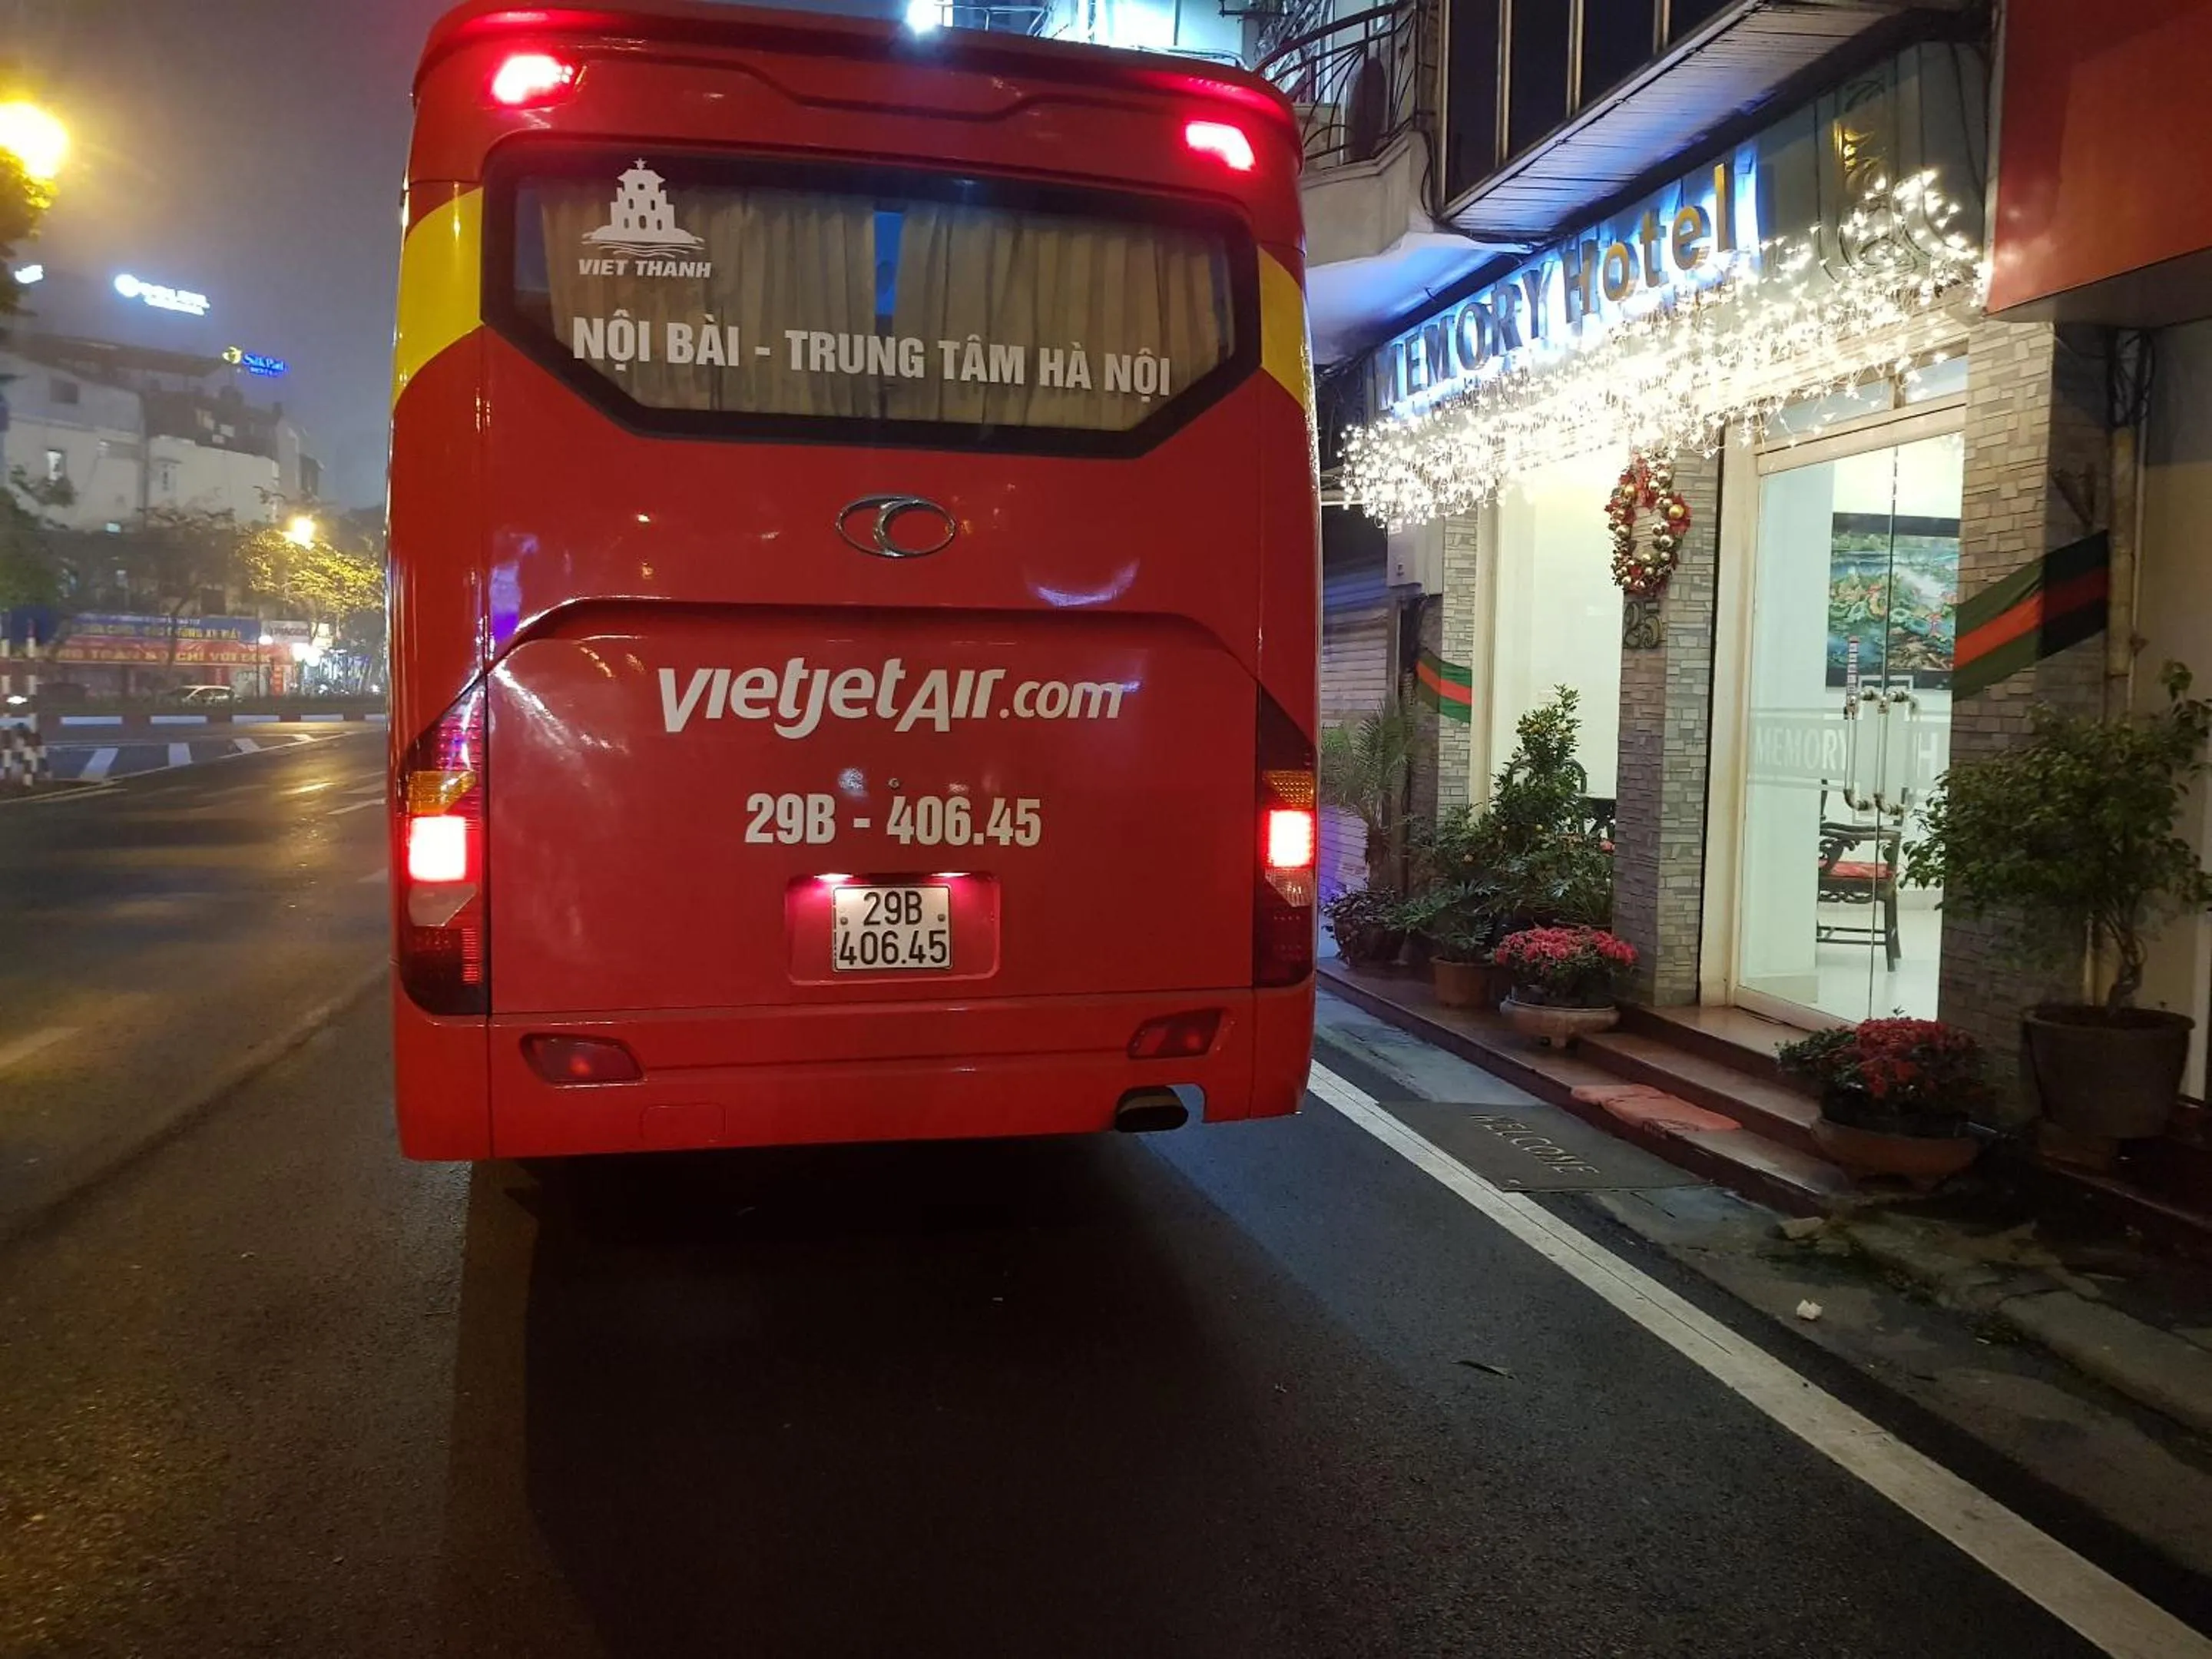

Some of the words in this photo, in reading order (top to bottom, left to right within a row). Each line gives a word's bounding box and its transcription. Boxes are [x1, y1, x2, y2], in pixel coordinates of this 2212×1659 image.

[578, 259, 628, 276] VIET
[635, 260, 712, 279] THANH
[1371, 260, 1555, 412] MEMORY
[1558, 161, 1737, 326] Hotel
[573, 309, 650, 372] NỘI
[667, 313, 740, 366] BÀI
[785, 329, 926, 379] TRUNG
[938, 334, 1025, 384] TÂM
[1039, 342, 1092, 390] HÀ
[1104, 347, 1171, 402] NỘI
[745, 793, 836, 844] 29B
[886, 796, 1041, 846] 406.45
[863, 891, 923, 926] 29B
[838, 930, 948, 966] 406.45
